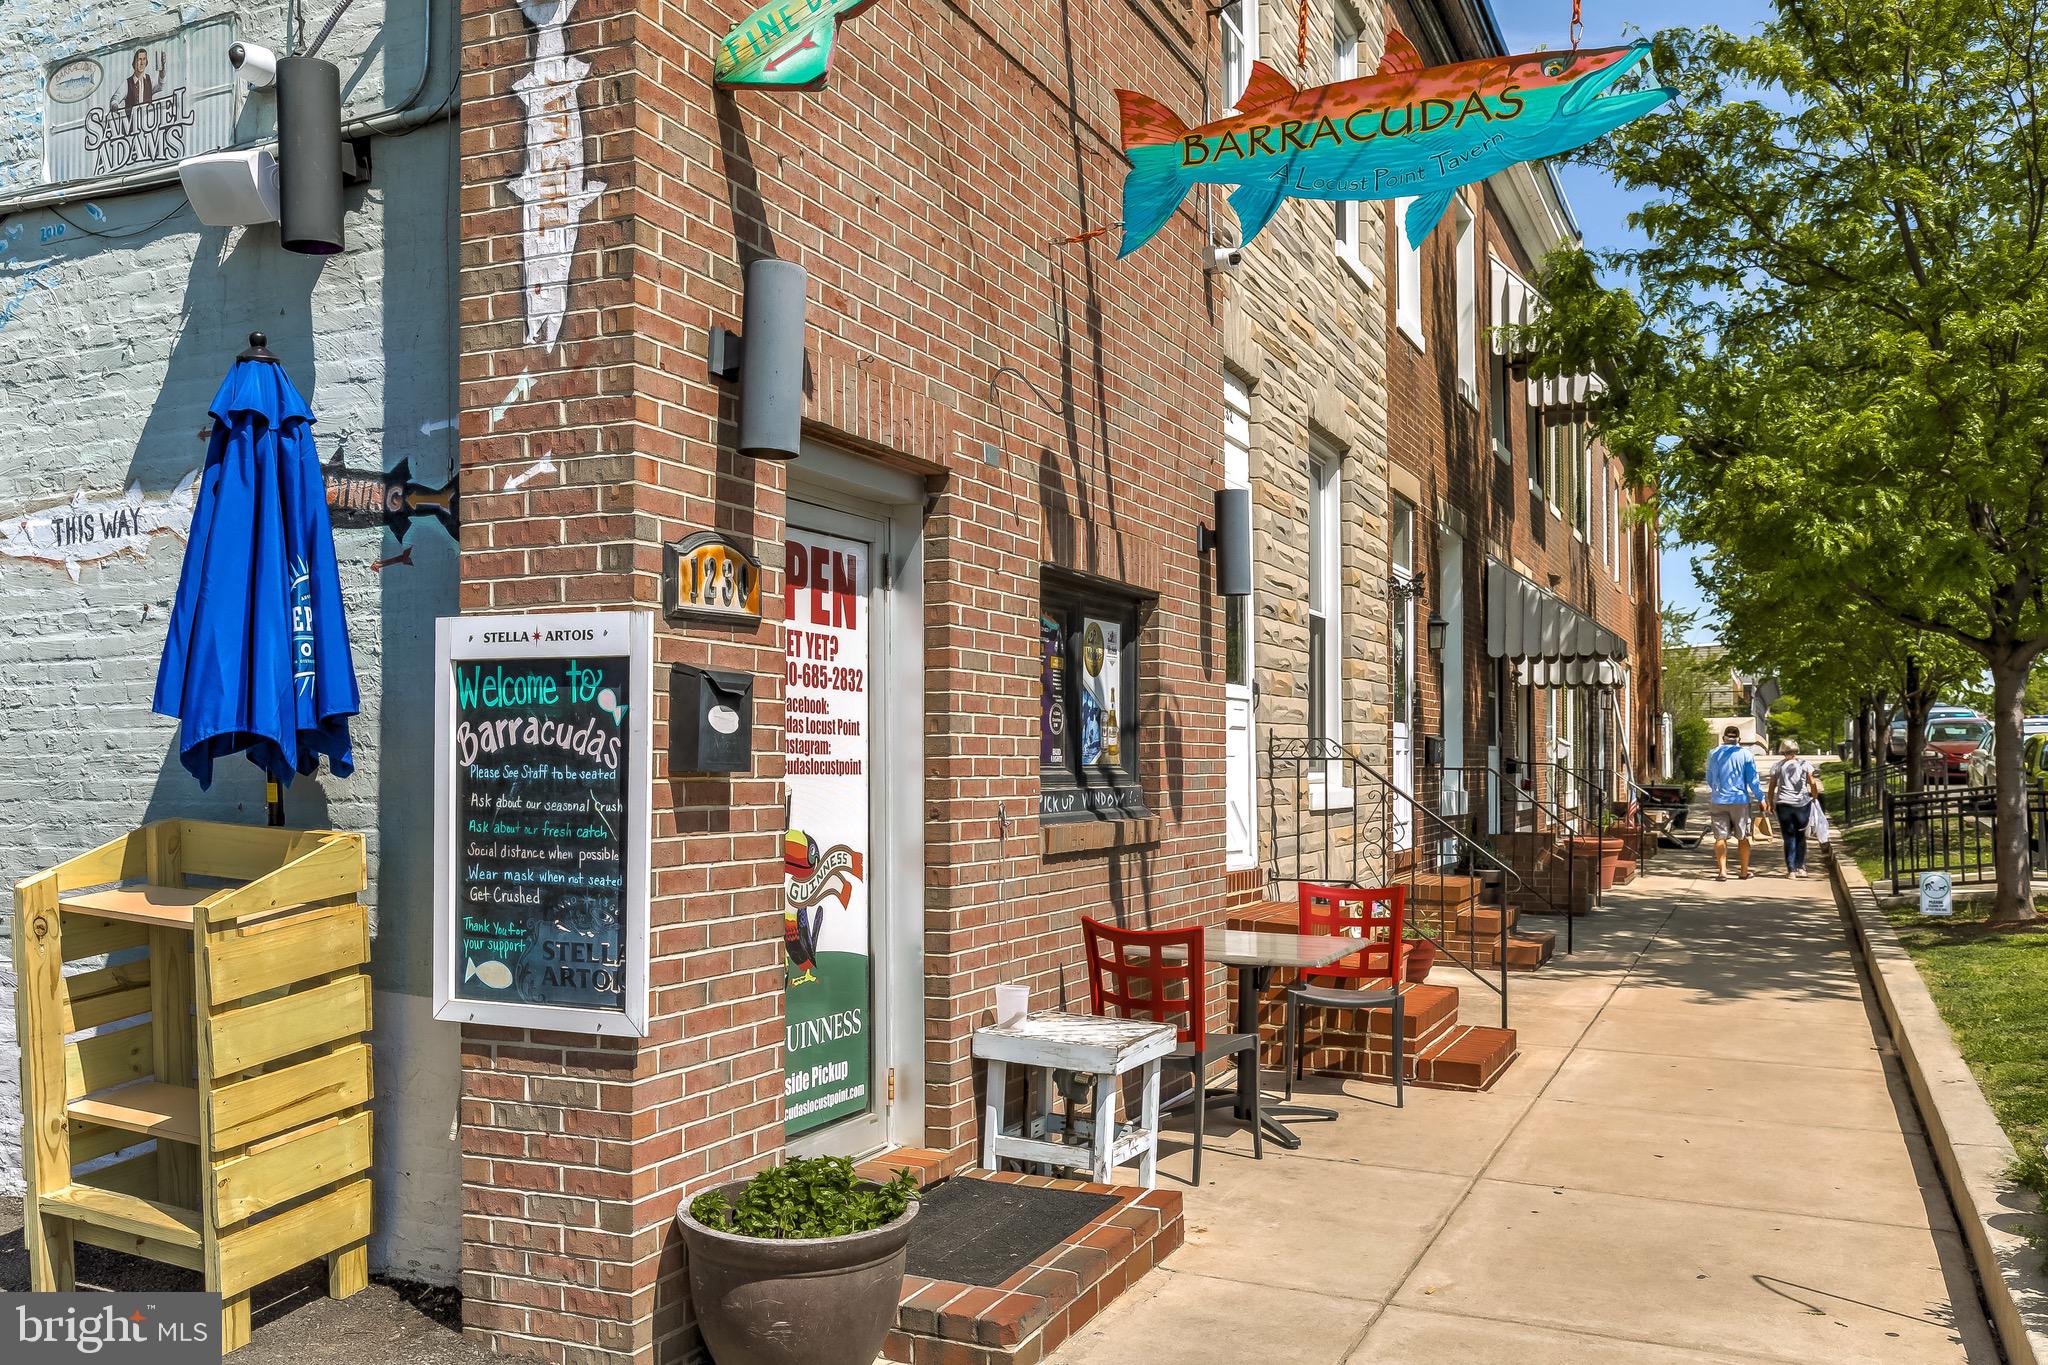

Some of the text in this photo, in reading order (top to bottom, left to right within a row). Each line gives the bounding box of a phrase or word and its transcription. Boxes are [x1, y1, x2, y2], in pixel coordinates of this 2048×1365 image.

[725, 4, 800, 65] FINE
[84, 86, 195, 151] SAMUEL
[1181, 83, 1525, 168] BARRACUDAS
[94, 125, 186, 177] ADAMS
[1268, 132, 1504, 192] A Locust Point Tavern
[40, 223, 67, 242] 2010
[52, 505, 141, 547] THIS WAY
[690, 556, 749, 609] 1230
[484, 629, 594, 643] STELLA ARTOIS
[805, 631, 839, 662] YET?
[457, 659, 603, 710] Welcome to
[806, 717, 836, 735] Locust
[838, 719, 860, 736] Point
[457, 716, 622, 770] Barracudas
[470, 764, 616, 780] Please See Staff to be seated
[785, 758, 862, 777] udaslocustpoint
[470, 792, 492, 808] Ask
[496, 795, 523, 809] about
[526, 799, 541, 809] our
[544, 799, 590, 812] seasonal
[1061, 794, 1074, 811] UP
[1081, 791, 1125, 808] WINDOW
[468, 820, 489, 833] Ask
[494, 821, 520, 834] about
[542, 821, 572, 838] fresh
[577, 824, 608, 839] catch
[467, 842, 620, 869] Social distance when possible
[467, 864, 623, 887] Wear mask when not seated
[790, 853, 848, 901] GUINNESS
[470, 885, 541, 904] Get Crushed
[463, 916, 490, 933] Thank
[507, 921, 527, 935] for
[463, 938, 526, 959] your support
[812, 1060, 848, 1088] Pickup
